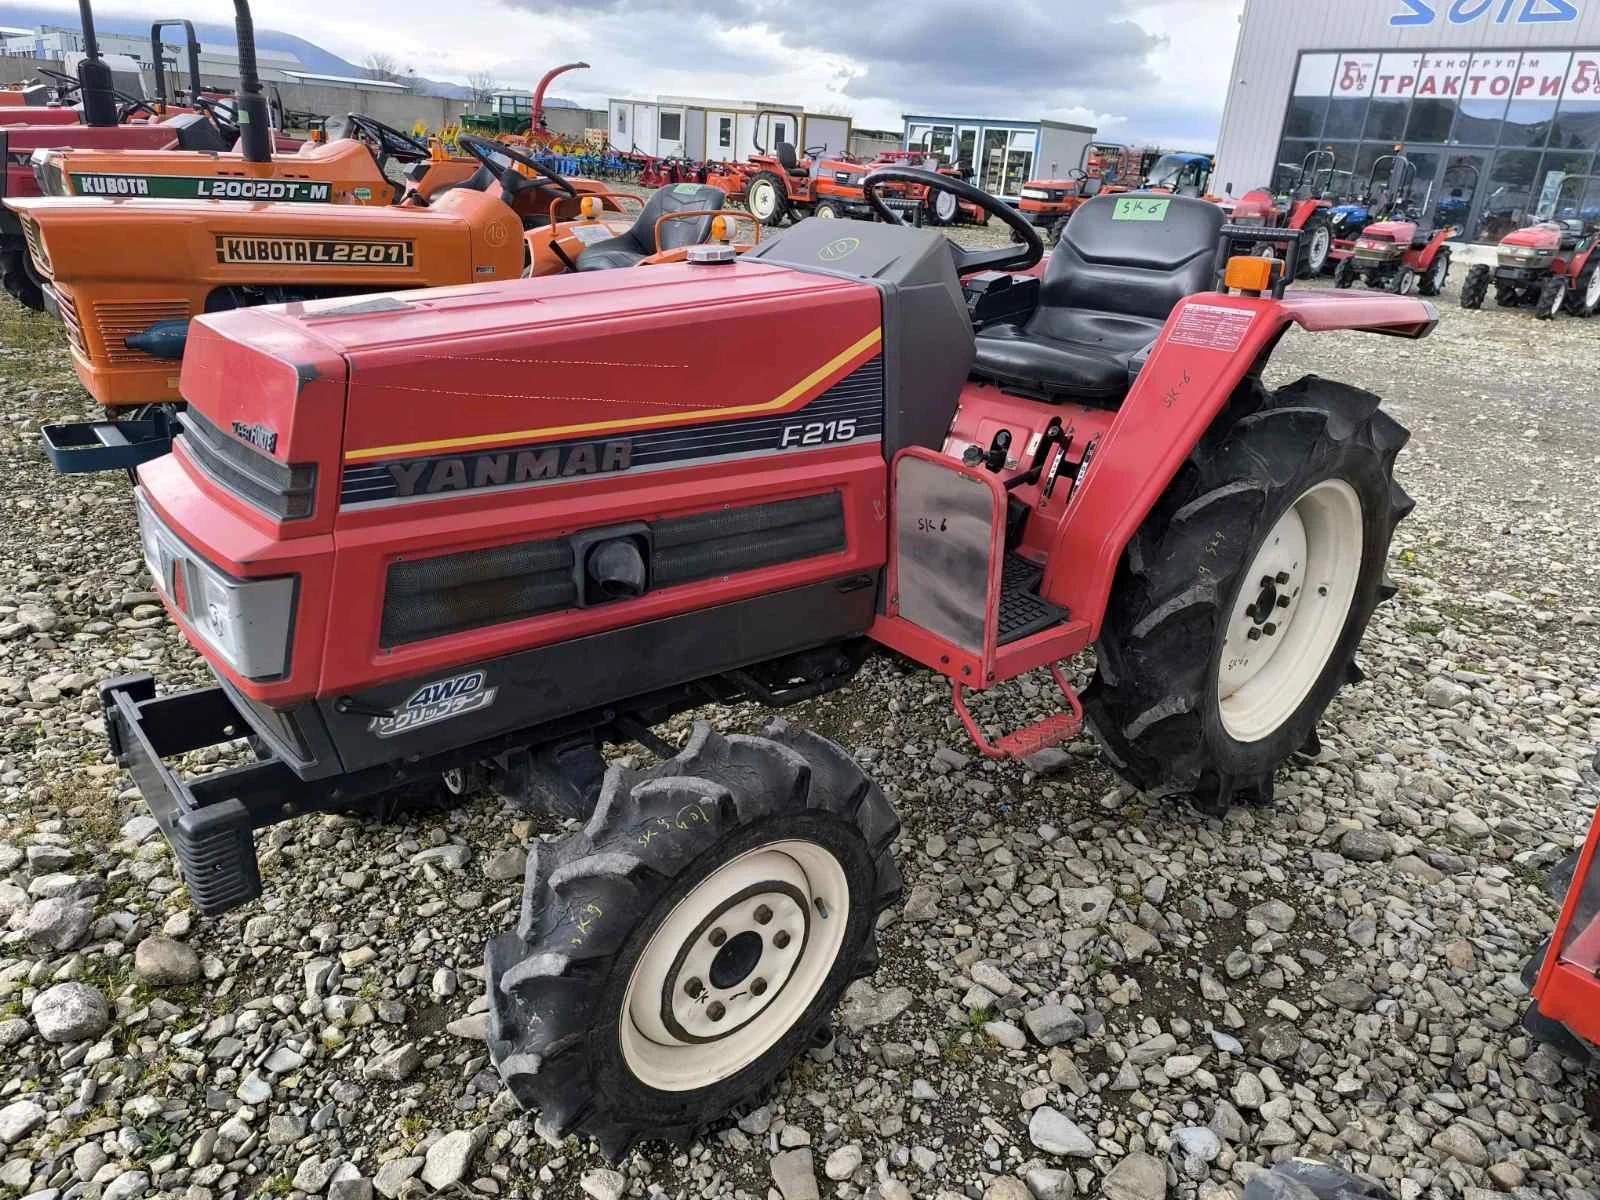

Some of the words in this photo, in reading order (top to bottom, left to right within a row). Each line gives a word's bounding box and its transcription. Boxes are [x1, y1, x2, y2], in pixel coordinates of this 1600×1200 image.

[1379, 75, 1562, 96] ТРАКТОРИ
[81, 176, 149, 195] KUBOTA
[196, 181, 328, 200] L2002DT-M
[227, 239, 308, 262] KUBOTA
[313, 243, 400, 263] L2201
[781, 418, 857, 447] F215
[385, 438, 633, 498] YANMAR
[408, 674, 480, 706] 4WD
